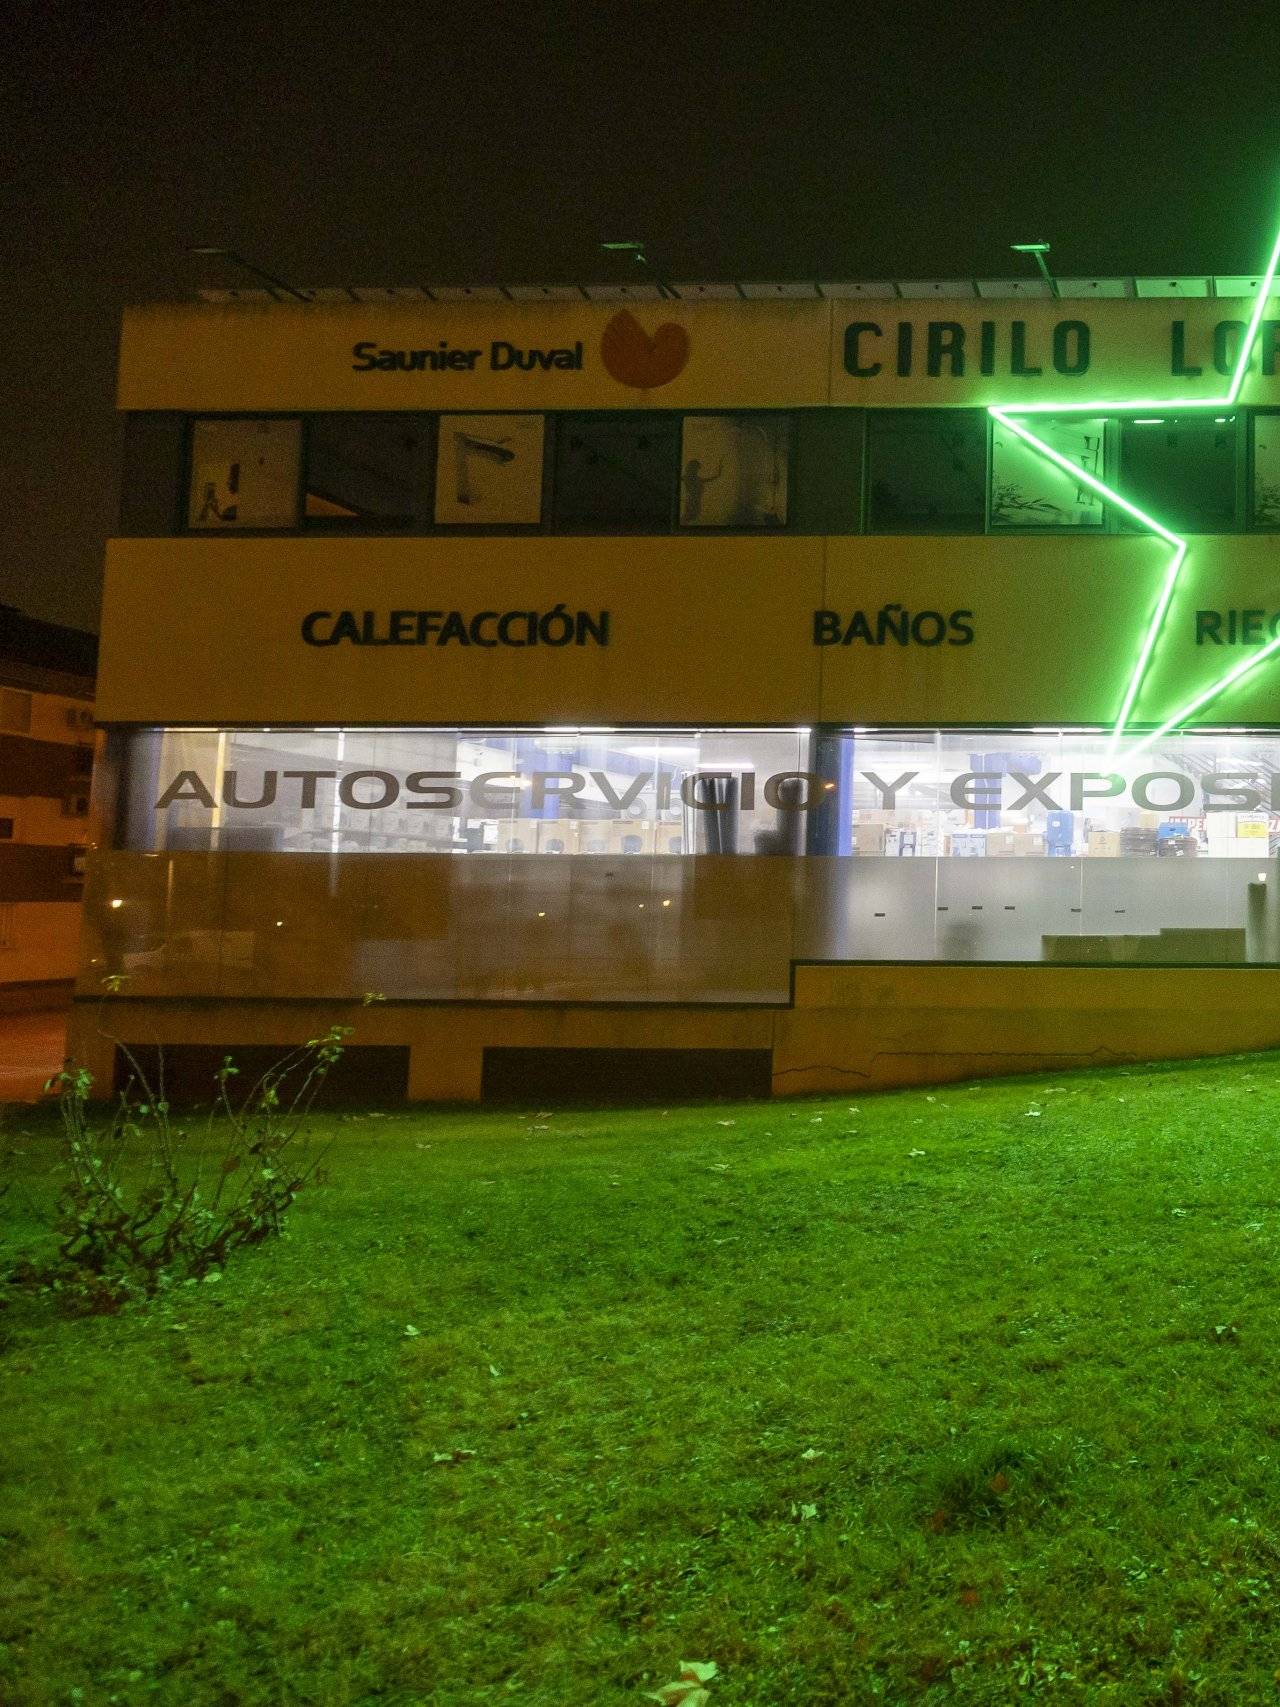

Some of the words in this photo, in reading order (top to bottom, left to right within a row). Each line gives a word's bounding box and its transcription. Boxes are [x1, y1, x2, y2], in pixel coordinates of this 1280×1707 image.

[352, 340, 482, 371] Saunier
[490, 341, 582, 371] Duval
[843, 320, 1090, 378] CIRILO
[301, 604, 610, 647] CALEFACCIÓN
[812, 604, 974, 647] BAÑOS
[154, 769, 818, 812] AUTOSERVICIO
[861, 771, 917, 811] Y
